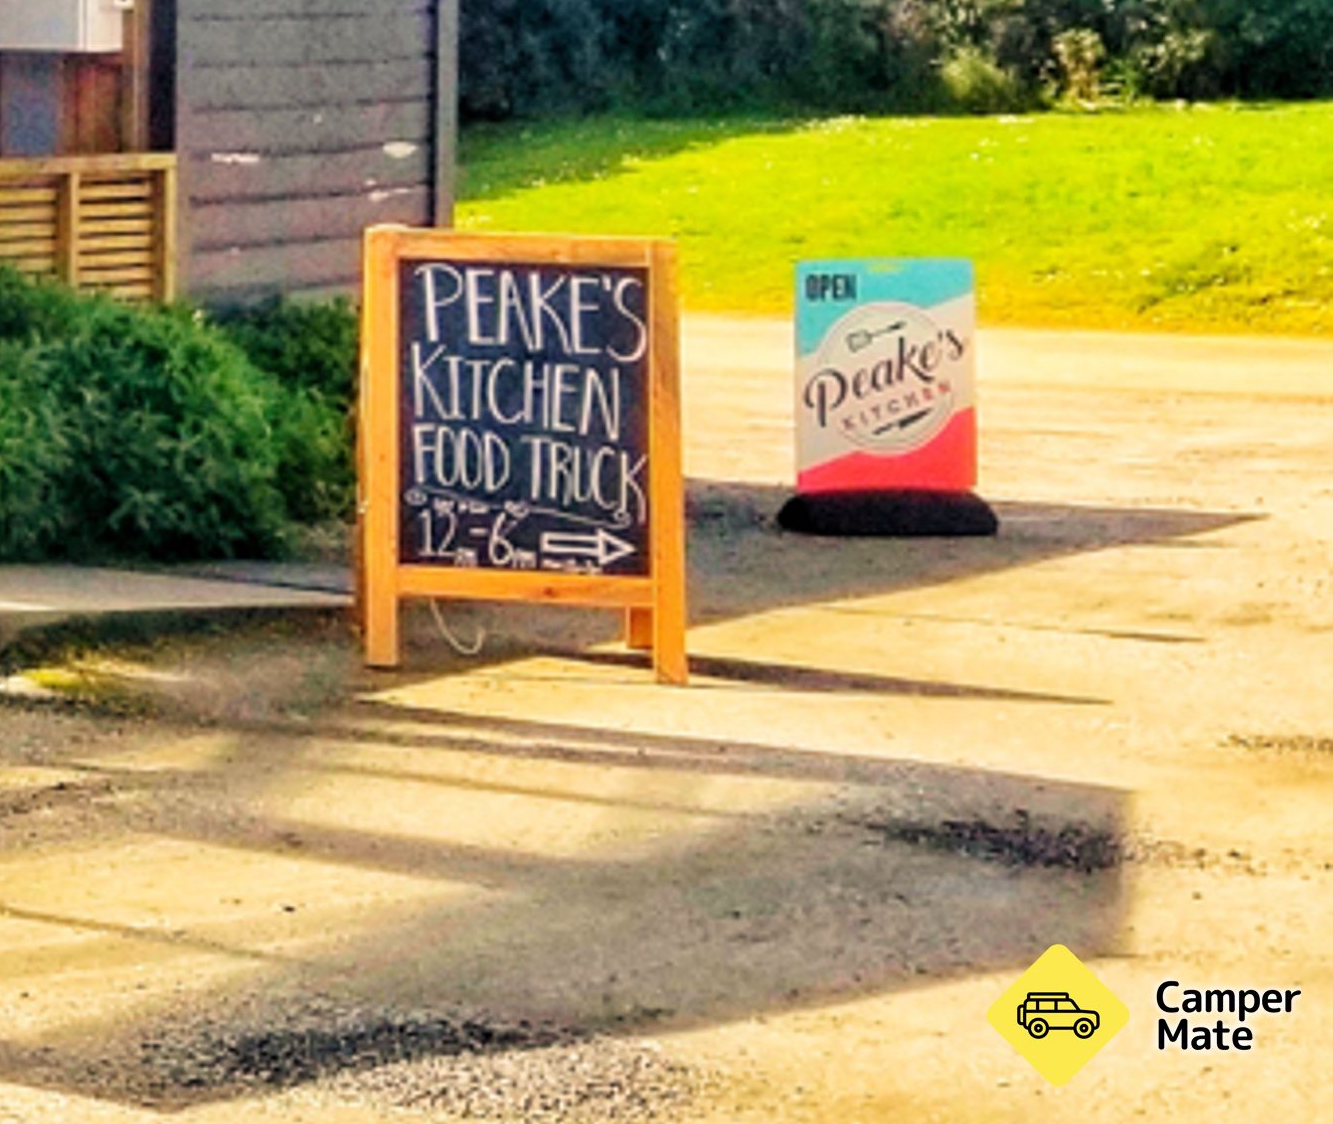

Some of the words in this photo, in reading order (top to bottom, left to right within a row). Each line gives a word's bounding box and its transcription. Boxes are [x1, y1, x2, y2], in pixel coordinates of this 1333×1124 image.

[414, 262, 648, 363] PEAKE'S
[805, 274, 857, 301] OPEN
[411, 341, 620, 441] KITCHEN
[804, 329, 963, 428] Peake's
[843, 380, 951, 430] KITCHEN
[413, 423, 510, 493] FOOD
[521, 435, 648, 523] TRUCK
